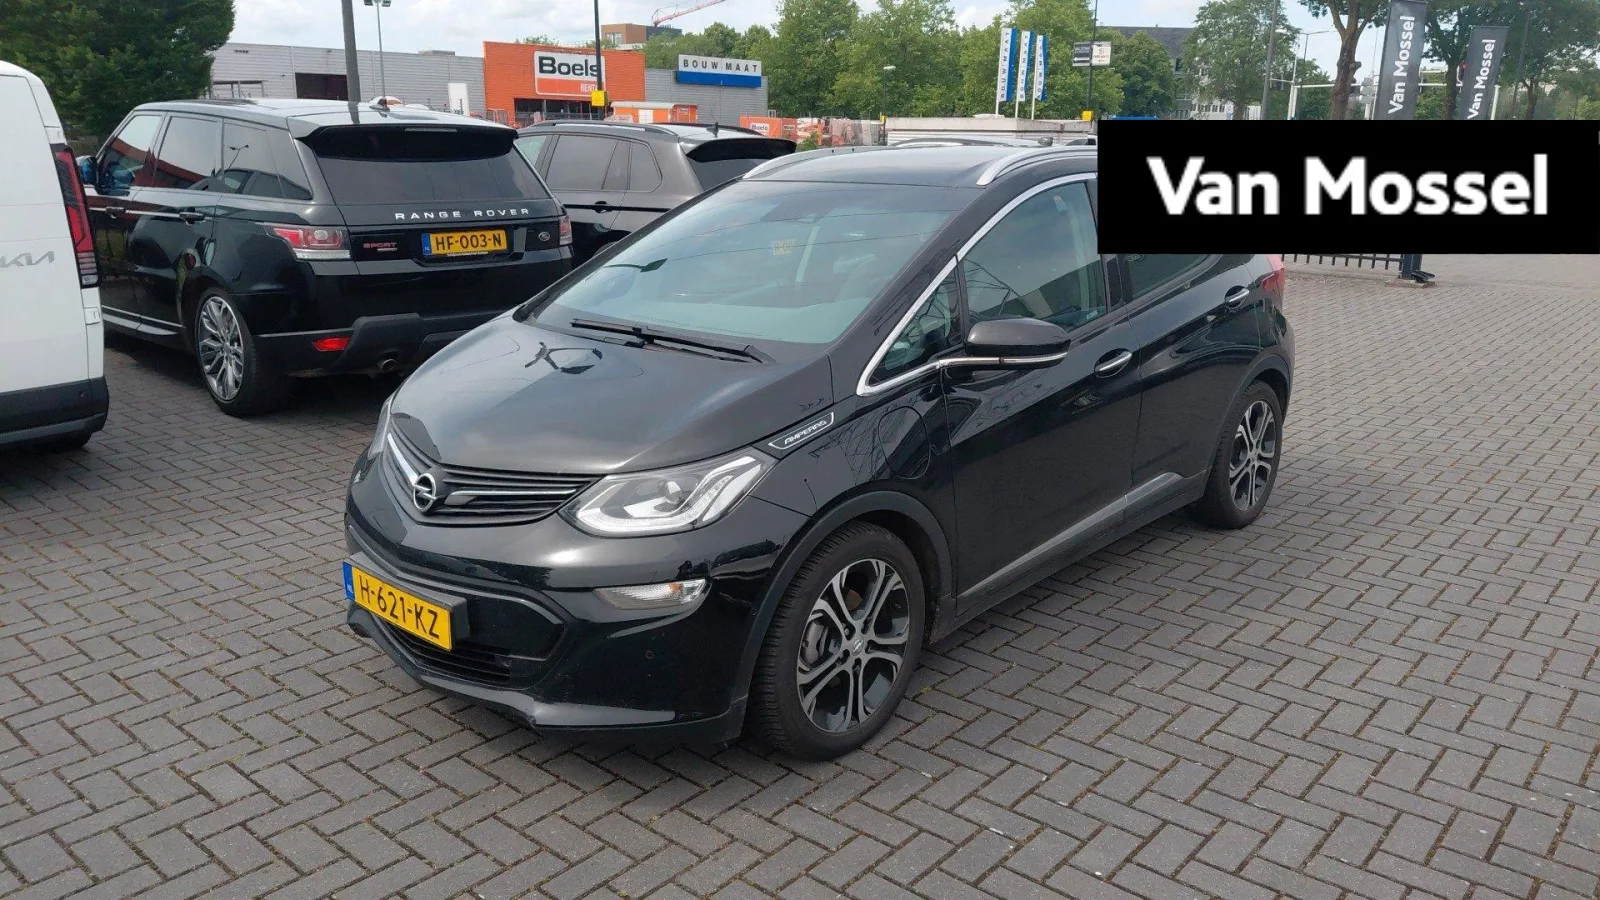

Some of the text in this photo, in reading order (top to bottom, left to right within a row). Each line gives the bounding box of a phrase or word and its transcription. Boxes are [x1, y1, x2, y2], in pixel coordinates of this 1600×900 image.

[538, 56, 598, 77] Boels
[1387, 16, 1416, 114] Van Mossel
[1467, 39, 1496, 119] Van Mossel
[395, 208, 530, 220] RANGE ROVER
[435, 233, 502, 251] HF-003-N
[358, 575, 440, 639] H-621-KZ
